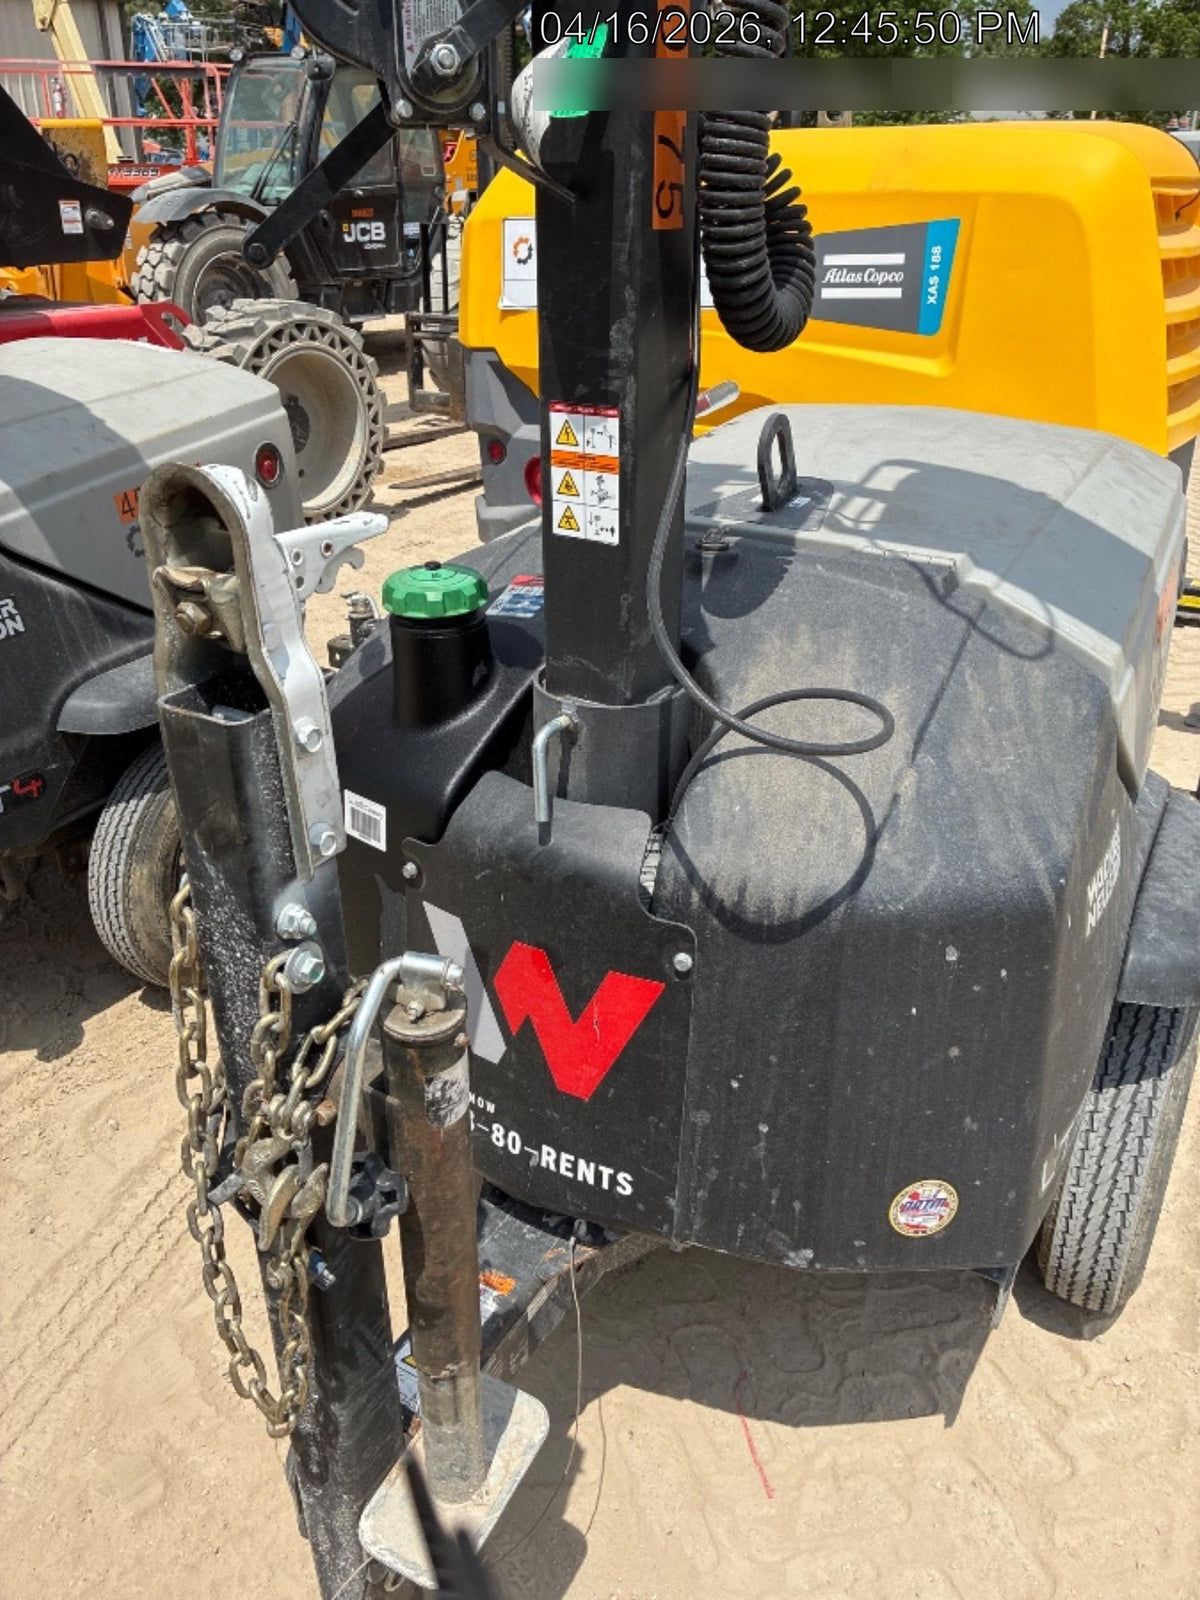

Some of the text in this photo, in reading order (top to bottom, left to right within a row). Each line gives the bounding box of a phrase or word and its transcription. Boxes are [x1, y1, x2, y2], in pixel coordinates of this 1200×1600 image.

[342, 221, 387, 243] JCB
[926, 245, 943, 305] XAS 188
